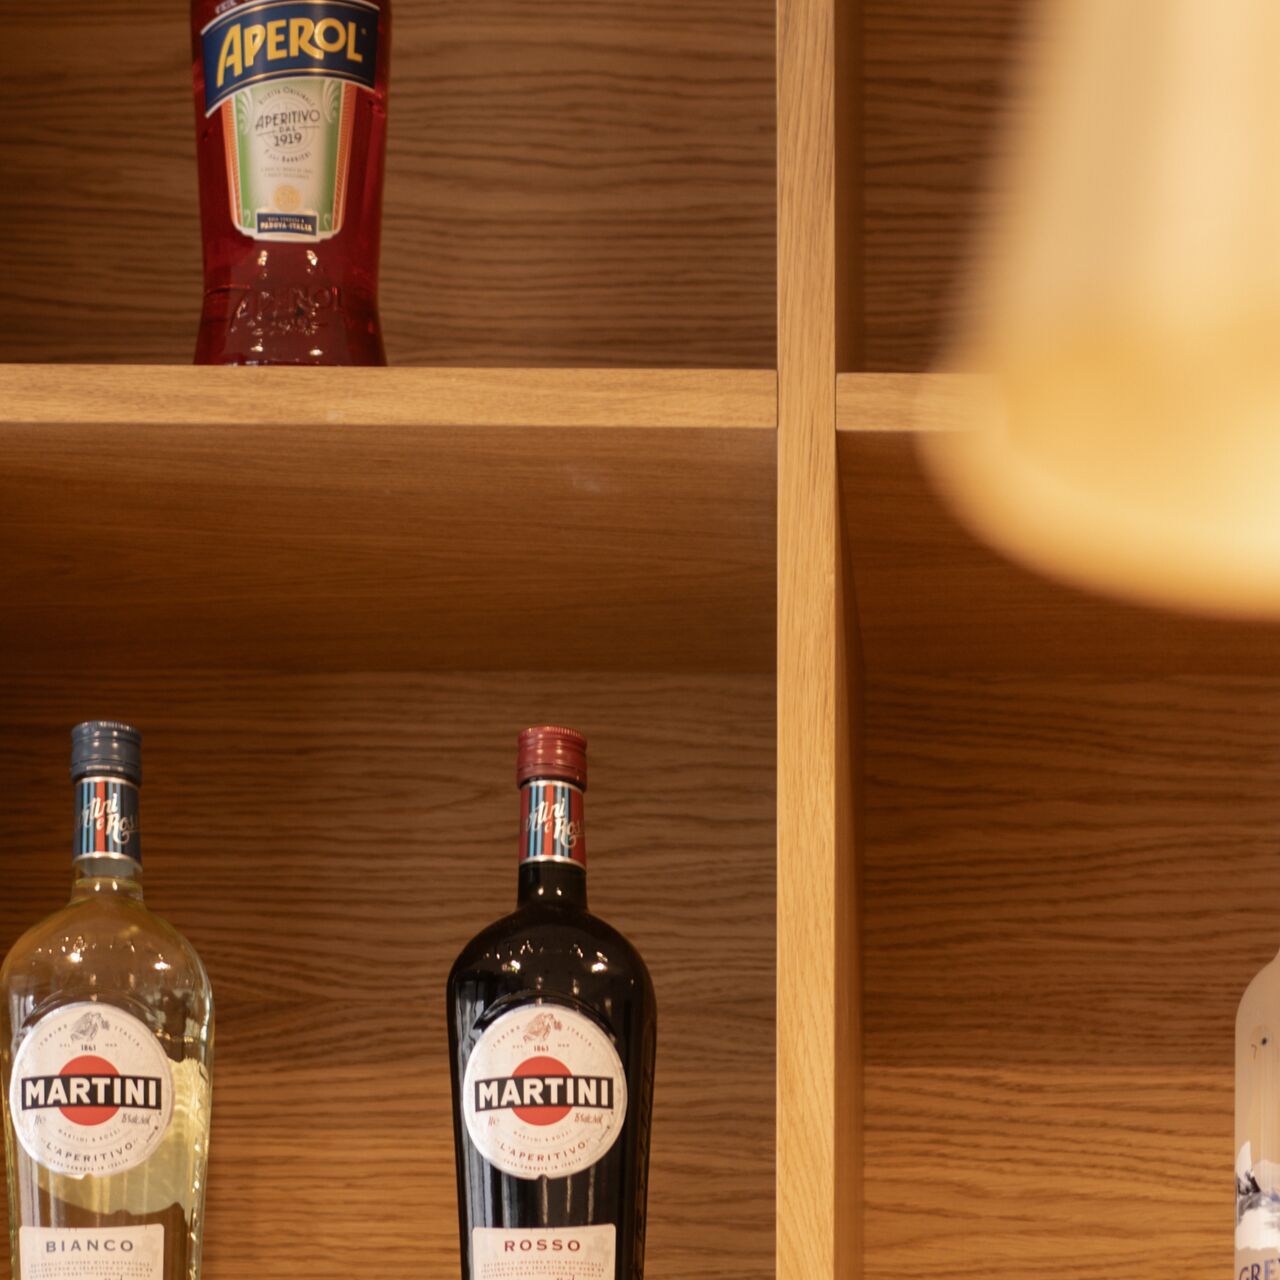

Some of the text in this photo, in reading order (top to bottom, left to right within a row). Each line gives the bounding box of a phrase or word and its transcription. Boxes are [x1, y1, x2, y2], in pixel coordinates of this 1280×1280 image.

[216, 17, 363, 88] APEROL
[255, 109, 321, 131] APERITIVO
[274, 132, 303, 147] 1919
[25, 1077, 157, 1107] MARTINI
[479, 1077, 609, 1109] MARTINI
[46, 1239, 134, 1253] BIANCO
[504, 1239, 581, 1252] ROSSO
